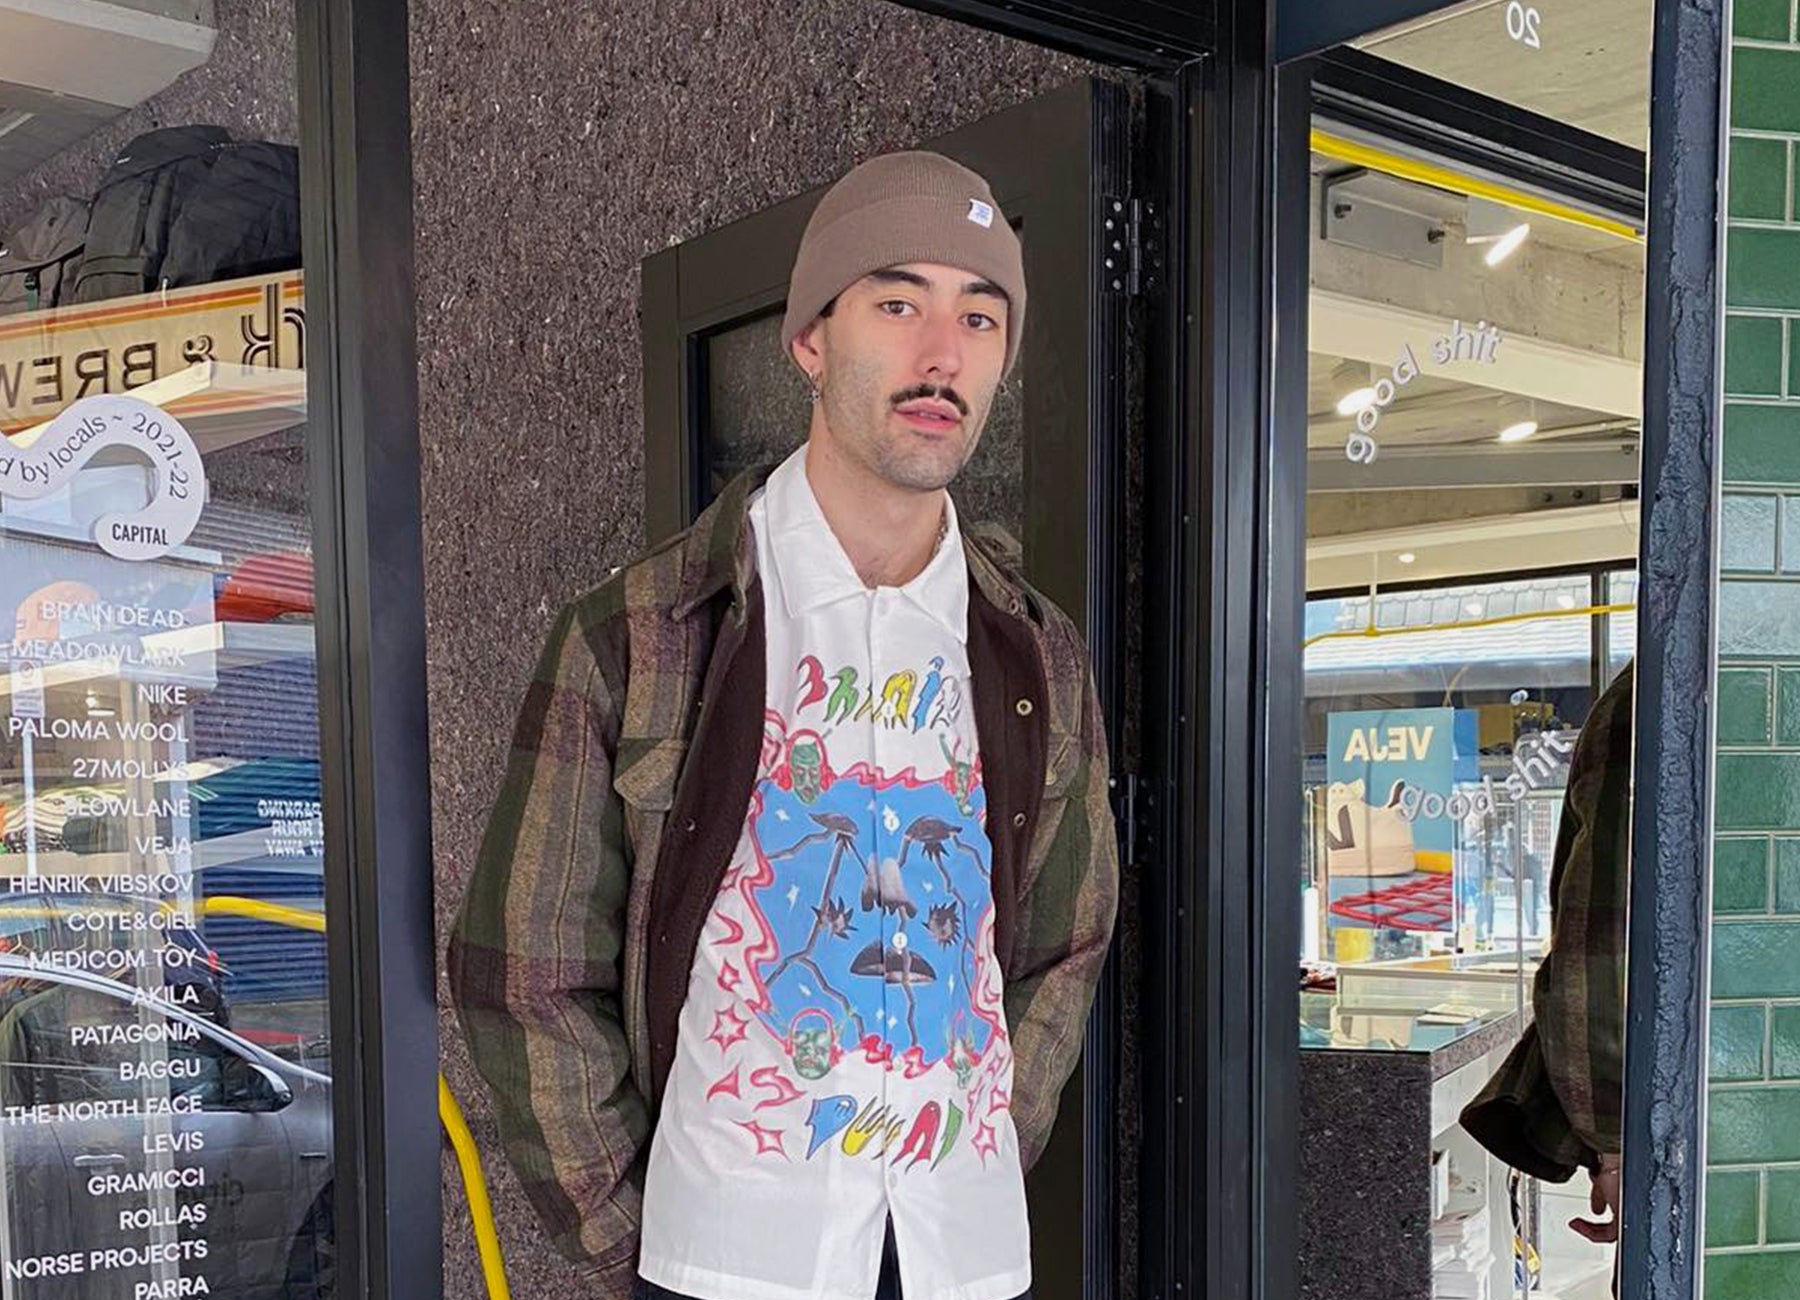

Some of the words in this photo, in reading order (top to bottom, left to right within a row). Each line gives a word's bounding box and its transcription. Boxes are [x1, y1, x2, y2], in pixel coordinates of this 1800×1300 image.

[1346, 343, 1421, 464] good
[1432, 319, 1503, 365] shit
[20, 461, 49, 485] by
[49, 416, 107, 469] locals
[132, 412, 189, 500] 2021-22
[112, 523, 169, 546] CAPITAL
[42, 601, 112, 622] BRAIN
[120, 606, 184, 628] DEAD
[13, 638, 185, 666] MEADOWLARK
[138, 683, 187, 705] NIKE
[9, 717, 110, 740] PALOMA
[116, 721, 189, 743] WOOL
[72, 758, 188, 778] 27MOLLYS
[1400, 774, 1496, 823] good
[1506, 730, 1573, 800] shit
[65, 798, 191, 818] SLOWLANE
[136, 836, 192, 855] VEJA
[9, 874, 92, 894] HENRIK
[97, 873, 194, 893] VIBSKOV
[29, 949, 146, 971] MEDICOM
[153, 948, 197, 968] TOY
[132, 985, 200, 1005] AKILA
[70, 1022, 201, 1046] PATAGONIA
[119, 1058, 201, 1081] BAGGU
[5, 1104, 52, 1126] THE
[58, 1099, 138, 1122] NORTH
[146, 1095, 203, 1116] FACE
[143, 1131, 205, 1154] LEVIS
[87, 1167, 205, 1196] GRAMICCI
[119, 1203, 207, 1230] ROLLAS
[5, 1253, 84, 1280] NORSE
[90, 1239, 208, 1271] PROJECTS
